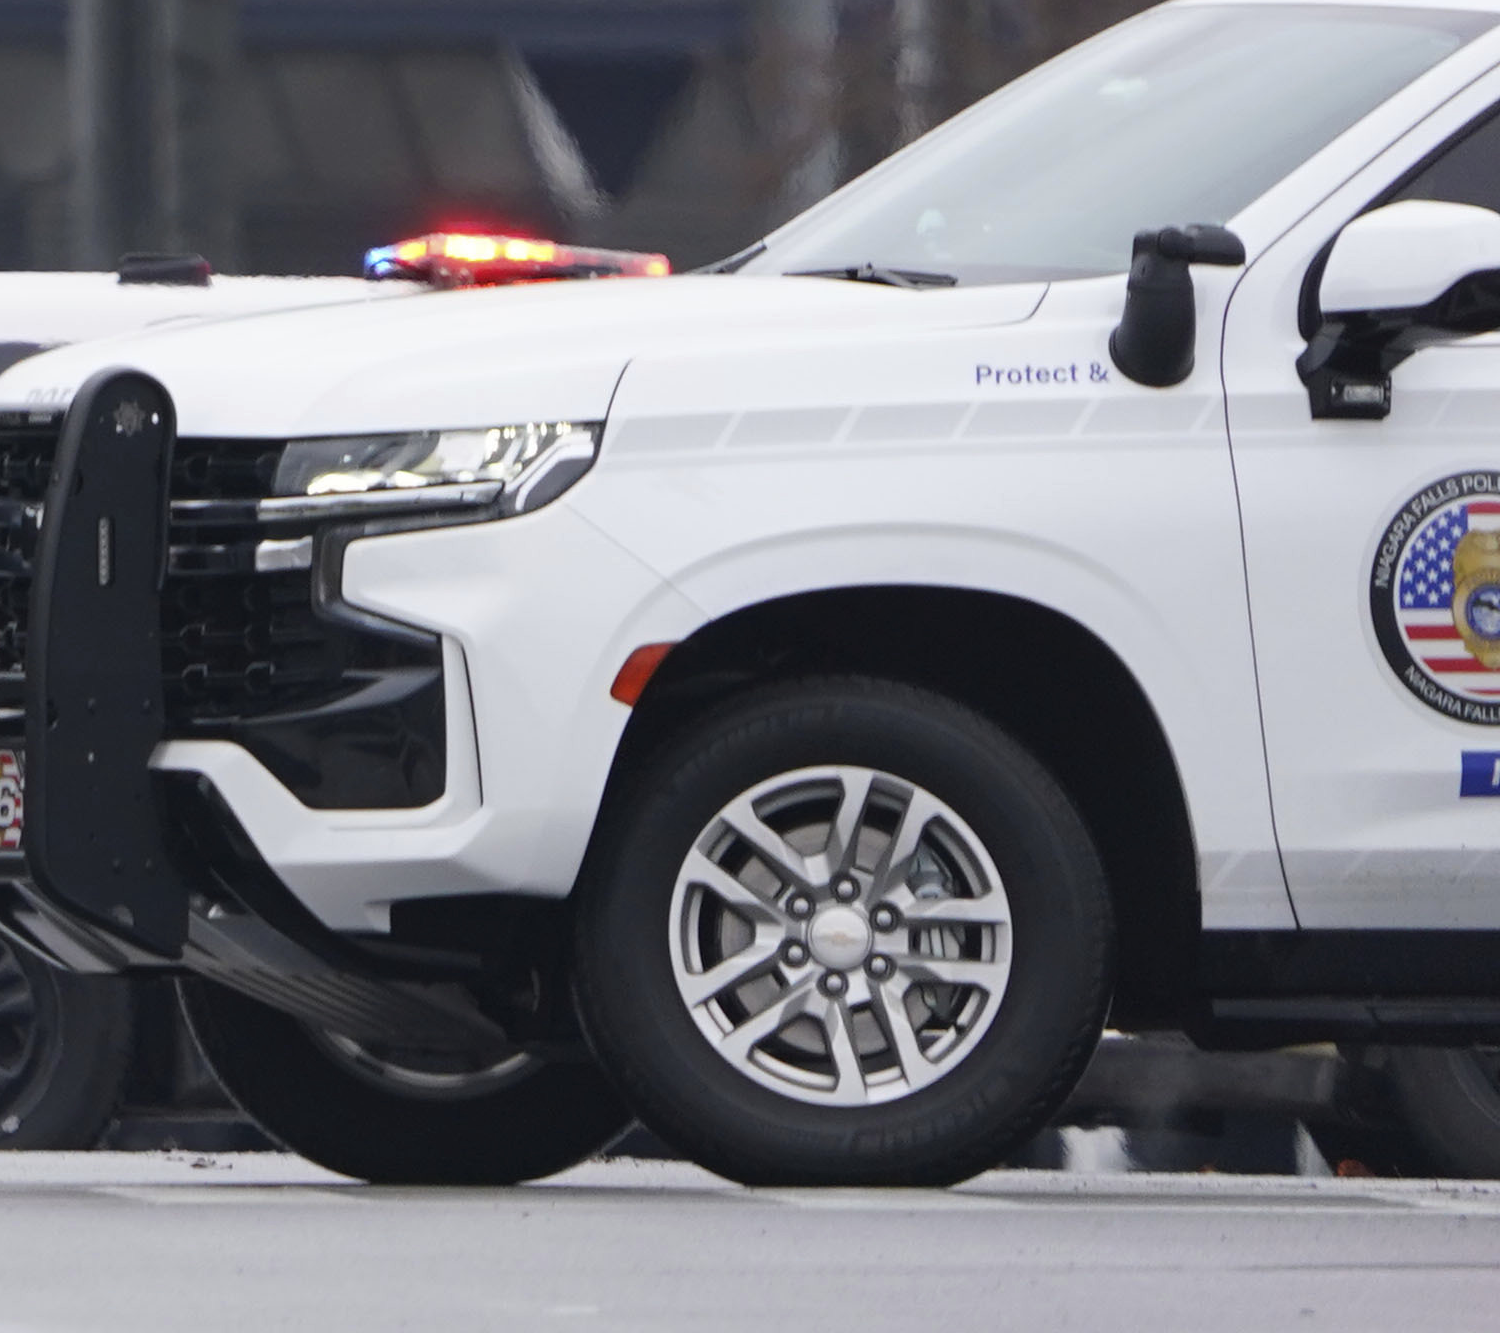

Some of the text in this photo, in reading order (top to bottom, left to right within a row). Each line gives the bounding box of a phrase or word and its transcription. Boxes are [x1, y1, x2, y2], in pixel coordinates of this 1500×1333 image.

[975, 361, 1109, 385] Protect &
[1374, 511, 1418, 590] NIAGARA
[1411, 478, 1460, 517] FALLS
[1403, 664, 1462, 717] NIAGARA
